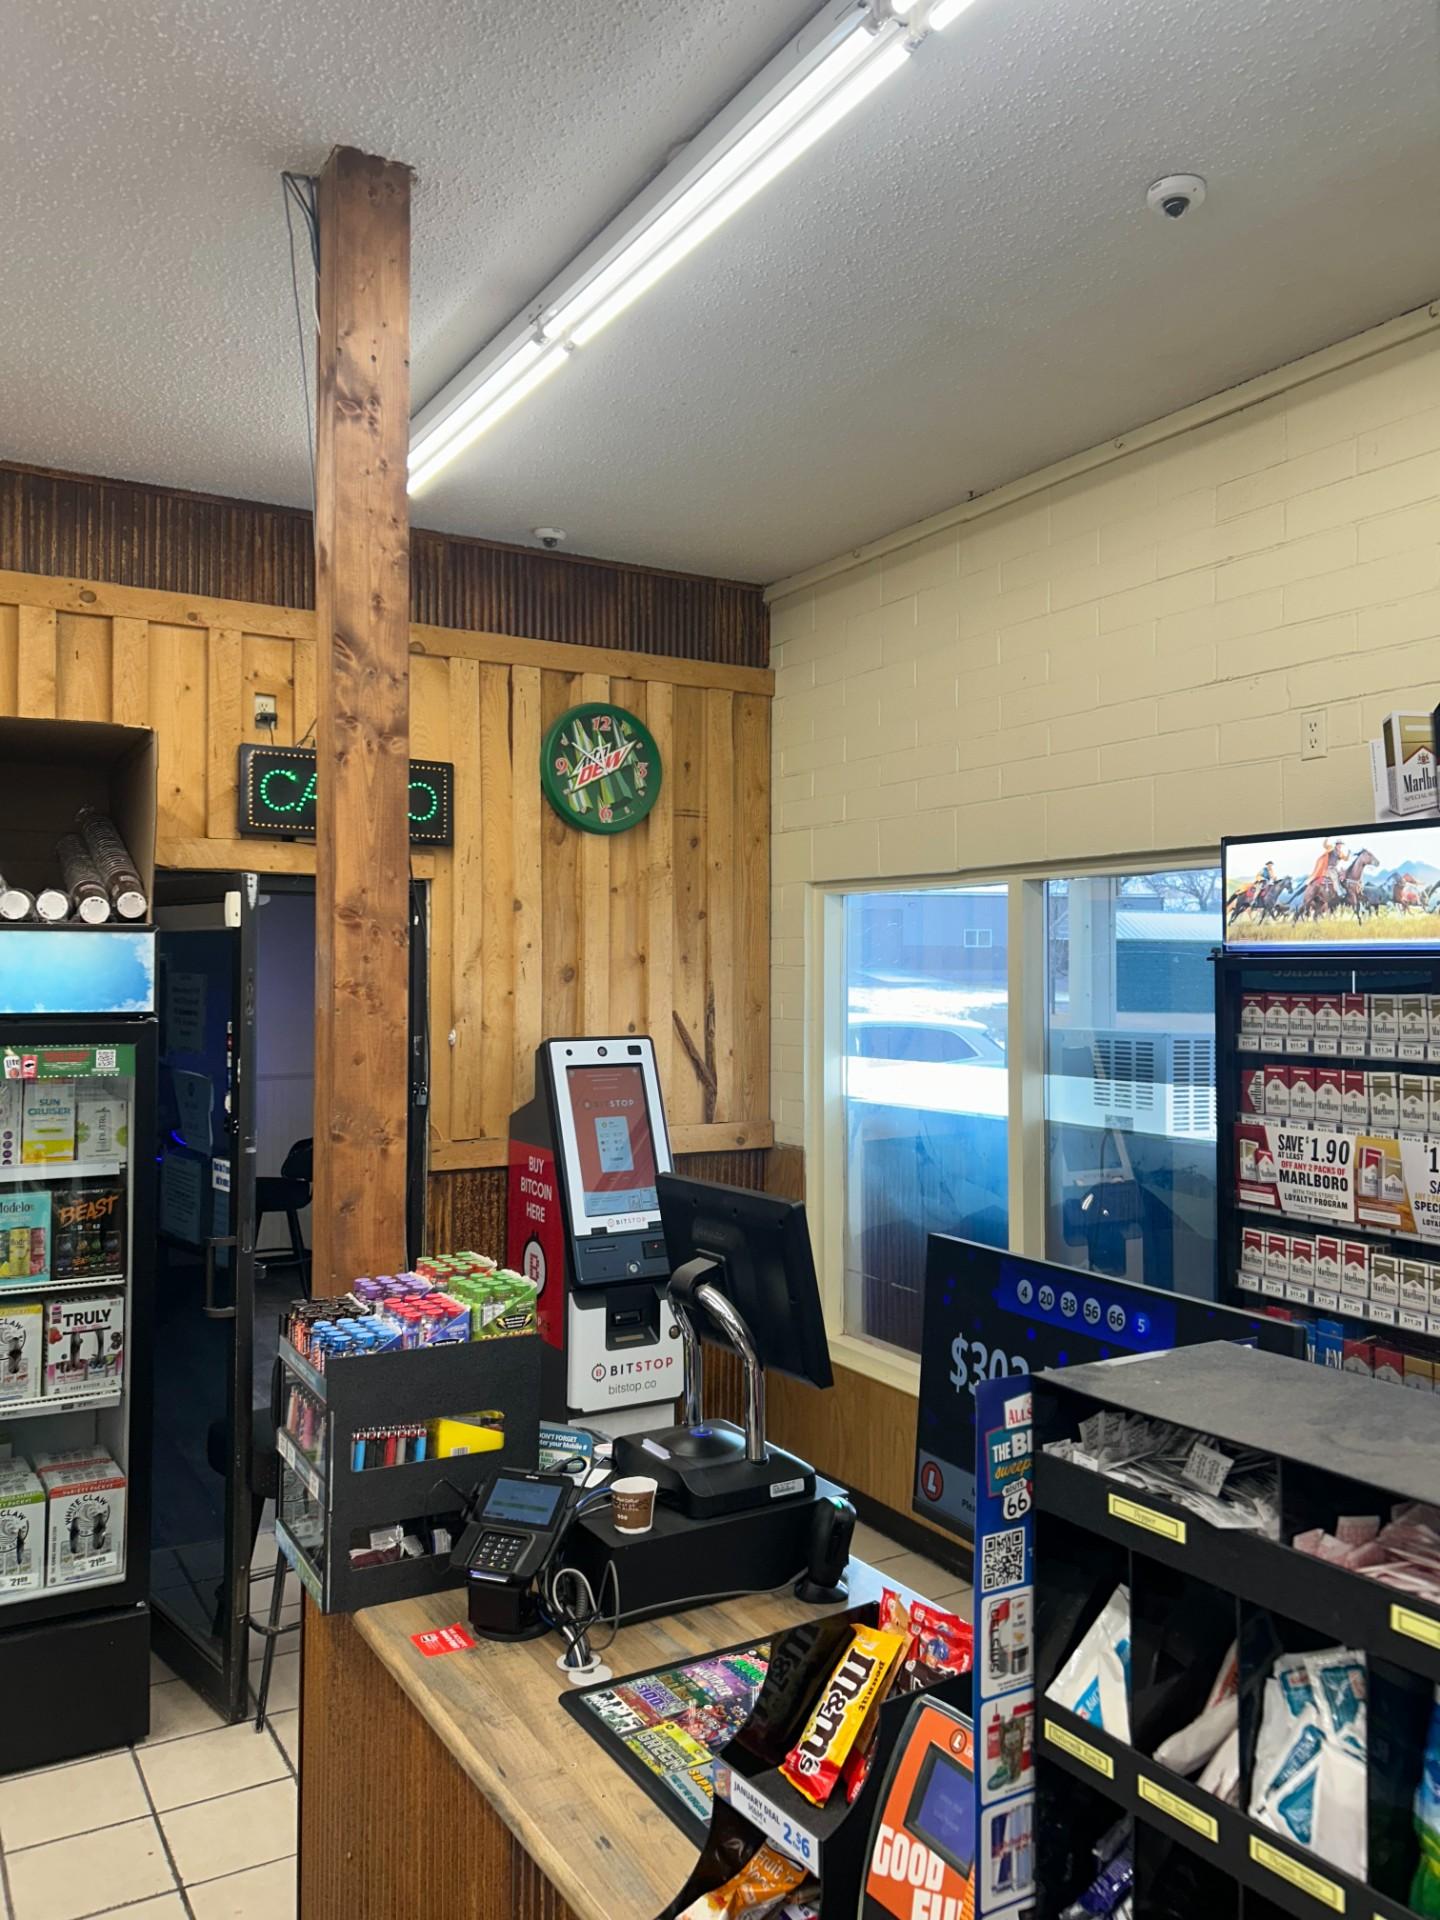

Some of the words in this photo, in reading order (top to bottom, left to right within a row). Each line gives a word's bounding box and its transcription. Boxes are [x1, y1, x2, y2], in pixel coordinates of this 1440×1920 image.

[592, 716, 611, 731] 12
[556, 758, 568, 775] 9
[577, 750, 630, 785] DEW
[27, 1107, 72, 1116] CRUISER
[1278, 1134, 1304, 1153] SAVE
[528, 1156, 544, 1175] BUY
[1286, 1152, 1304, 1161] LEAST
[1281, 1161, 1293, 1169] OFF
[1294, 1162, 1307, 1171] ANY
[1314, 1165, 1336, 1175] PACKS
[1337, 1168, 1346, 1176] OF
[520, 1177, 553, 1201] BITCOIN
[1279, 1169, 1349, 1192] MARLBORO
[59, 1195, 119, 1228] BEAST
[1284, 1193, 1313, 1204] LOYALTY
[1313, 1198, 1349, 1210] PROGRAM
[526, 1202, 546, 1223] HERE
[615, 1217, 647, 1227] BITSTOP
[63, 1308, 112, 1327] TRULY
[1021, 1286, 1028, 1299] 4
[1040, 1291, 1053, 1306] 20
[1062, 1297, 1076, 1313] 38
[1085, 1303, 1099, 1320] 56
[1108, 1310, 1124, 1327] 66
[1137, 1318, 1146, 1333] 5
[610, 1356, 674, 1377] BITSTOP
[608, 1380, 657, 1395] bitstop.co
[549, 1441, 562, 1449] your
[563, 1442, 583, 1450] Mobile
[555, 1434, 578, 1443] FORGET
[991, 1441, 1012, 1464] THE
[0, 1509, 26, 1521] CLAW
[64, 1498, 82, 1526] WHITE
[82, 1494, 108, 1506] CLAW
[1007, 1492, 1028, 1517] 66
[637, 1732, 690, 1772] GREEN
[734, 1781, 763, 1809] JANUARY
[763, 1804, 781, 1825] DEAL
[783, 1822, 793, 1845] 2
[759, 1848, 784, 1880] Fruit
[871, 1822, 946, 1892] GOOD
